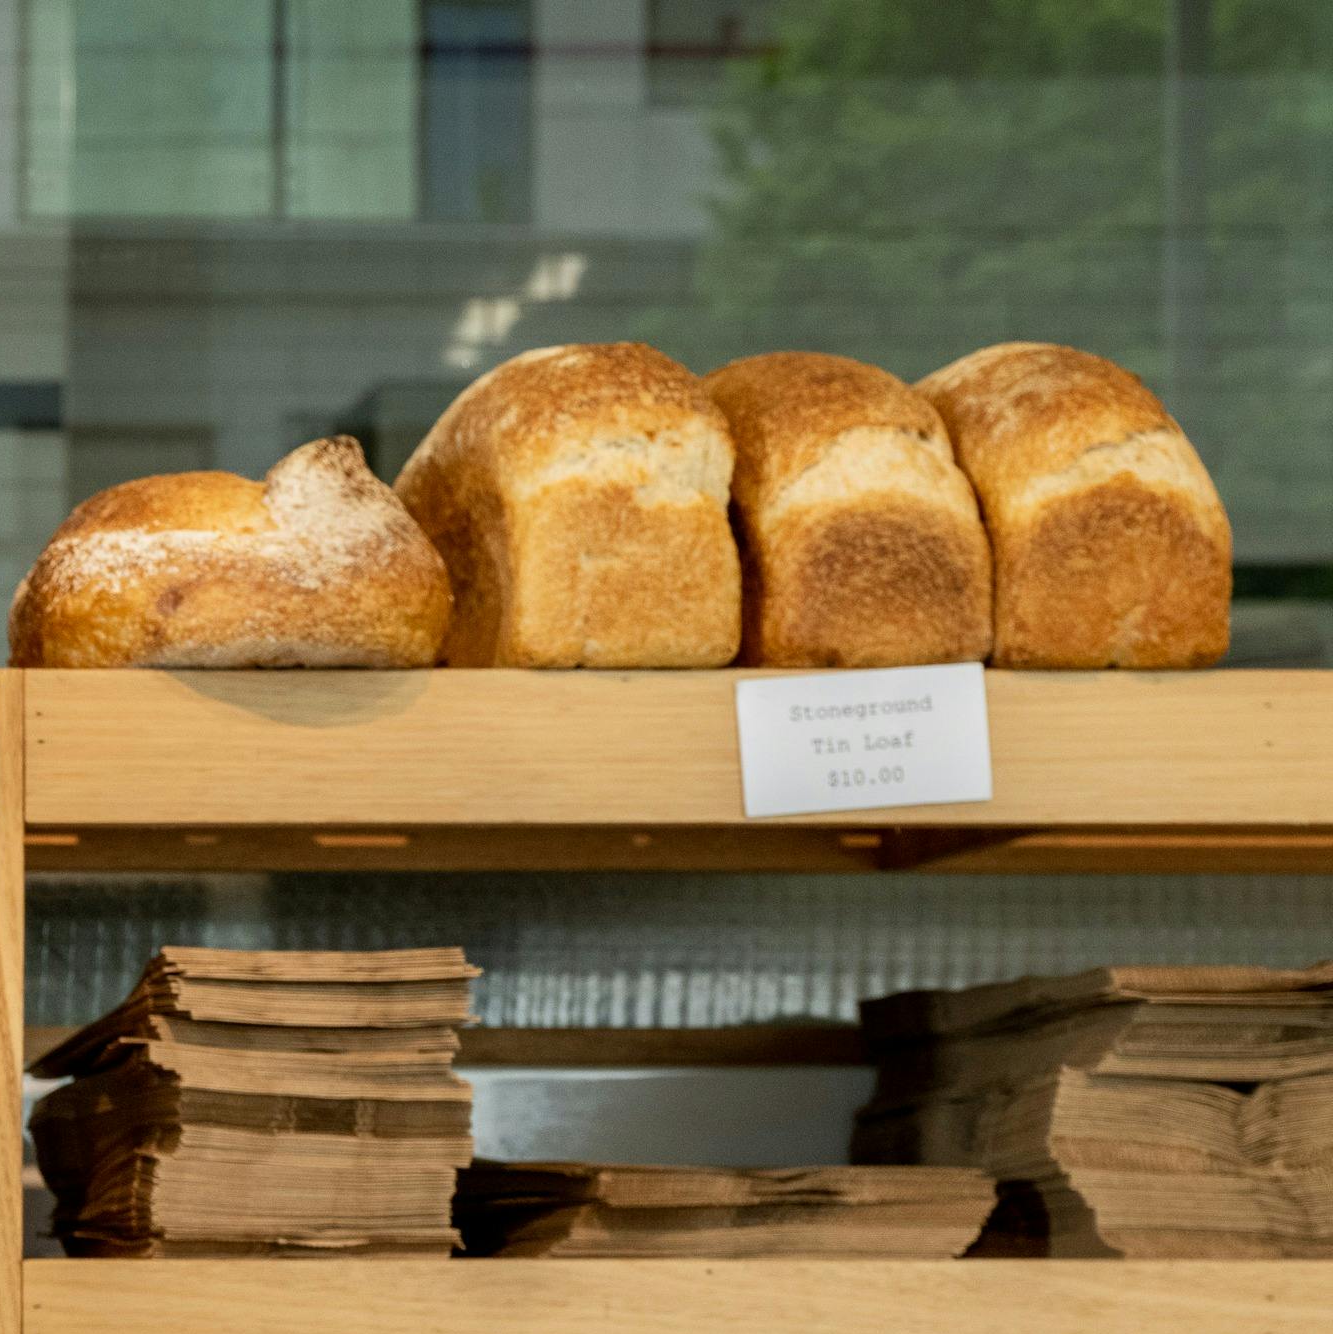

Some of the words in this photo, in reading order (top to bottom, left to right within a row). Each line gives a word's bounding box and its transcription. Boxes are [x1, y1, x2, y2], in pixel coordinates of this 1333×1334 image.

[789, 695, 933, 722] Stoneground
[811, 737, 851, 755] Tin
[864, 730, 914, 751] Loaf
[827, 766, 906, 787] $10.00
